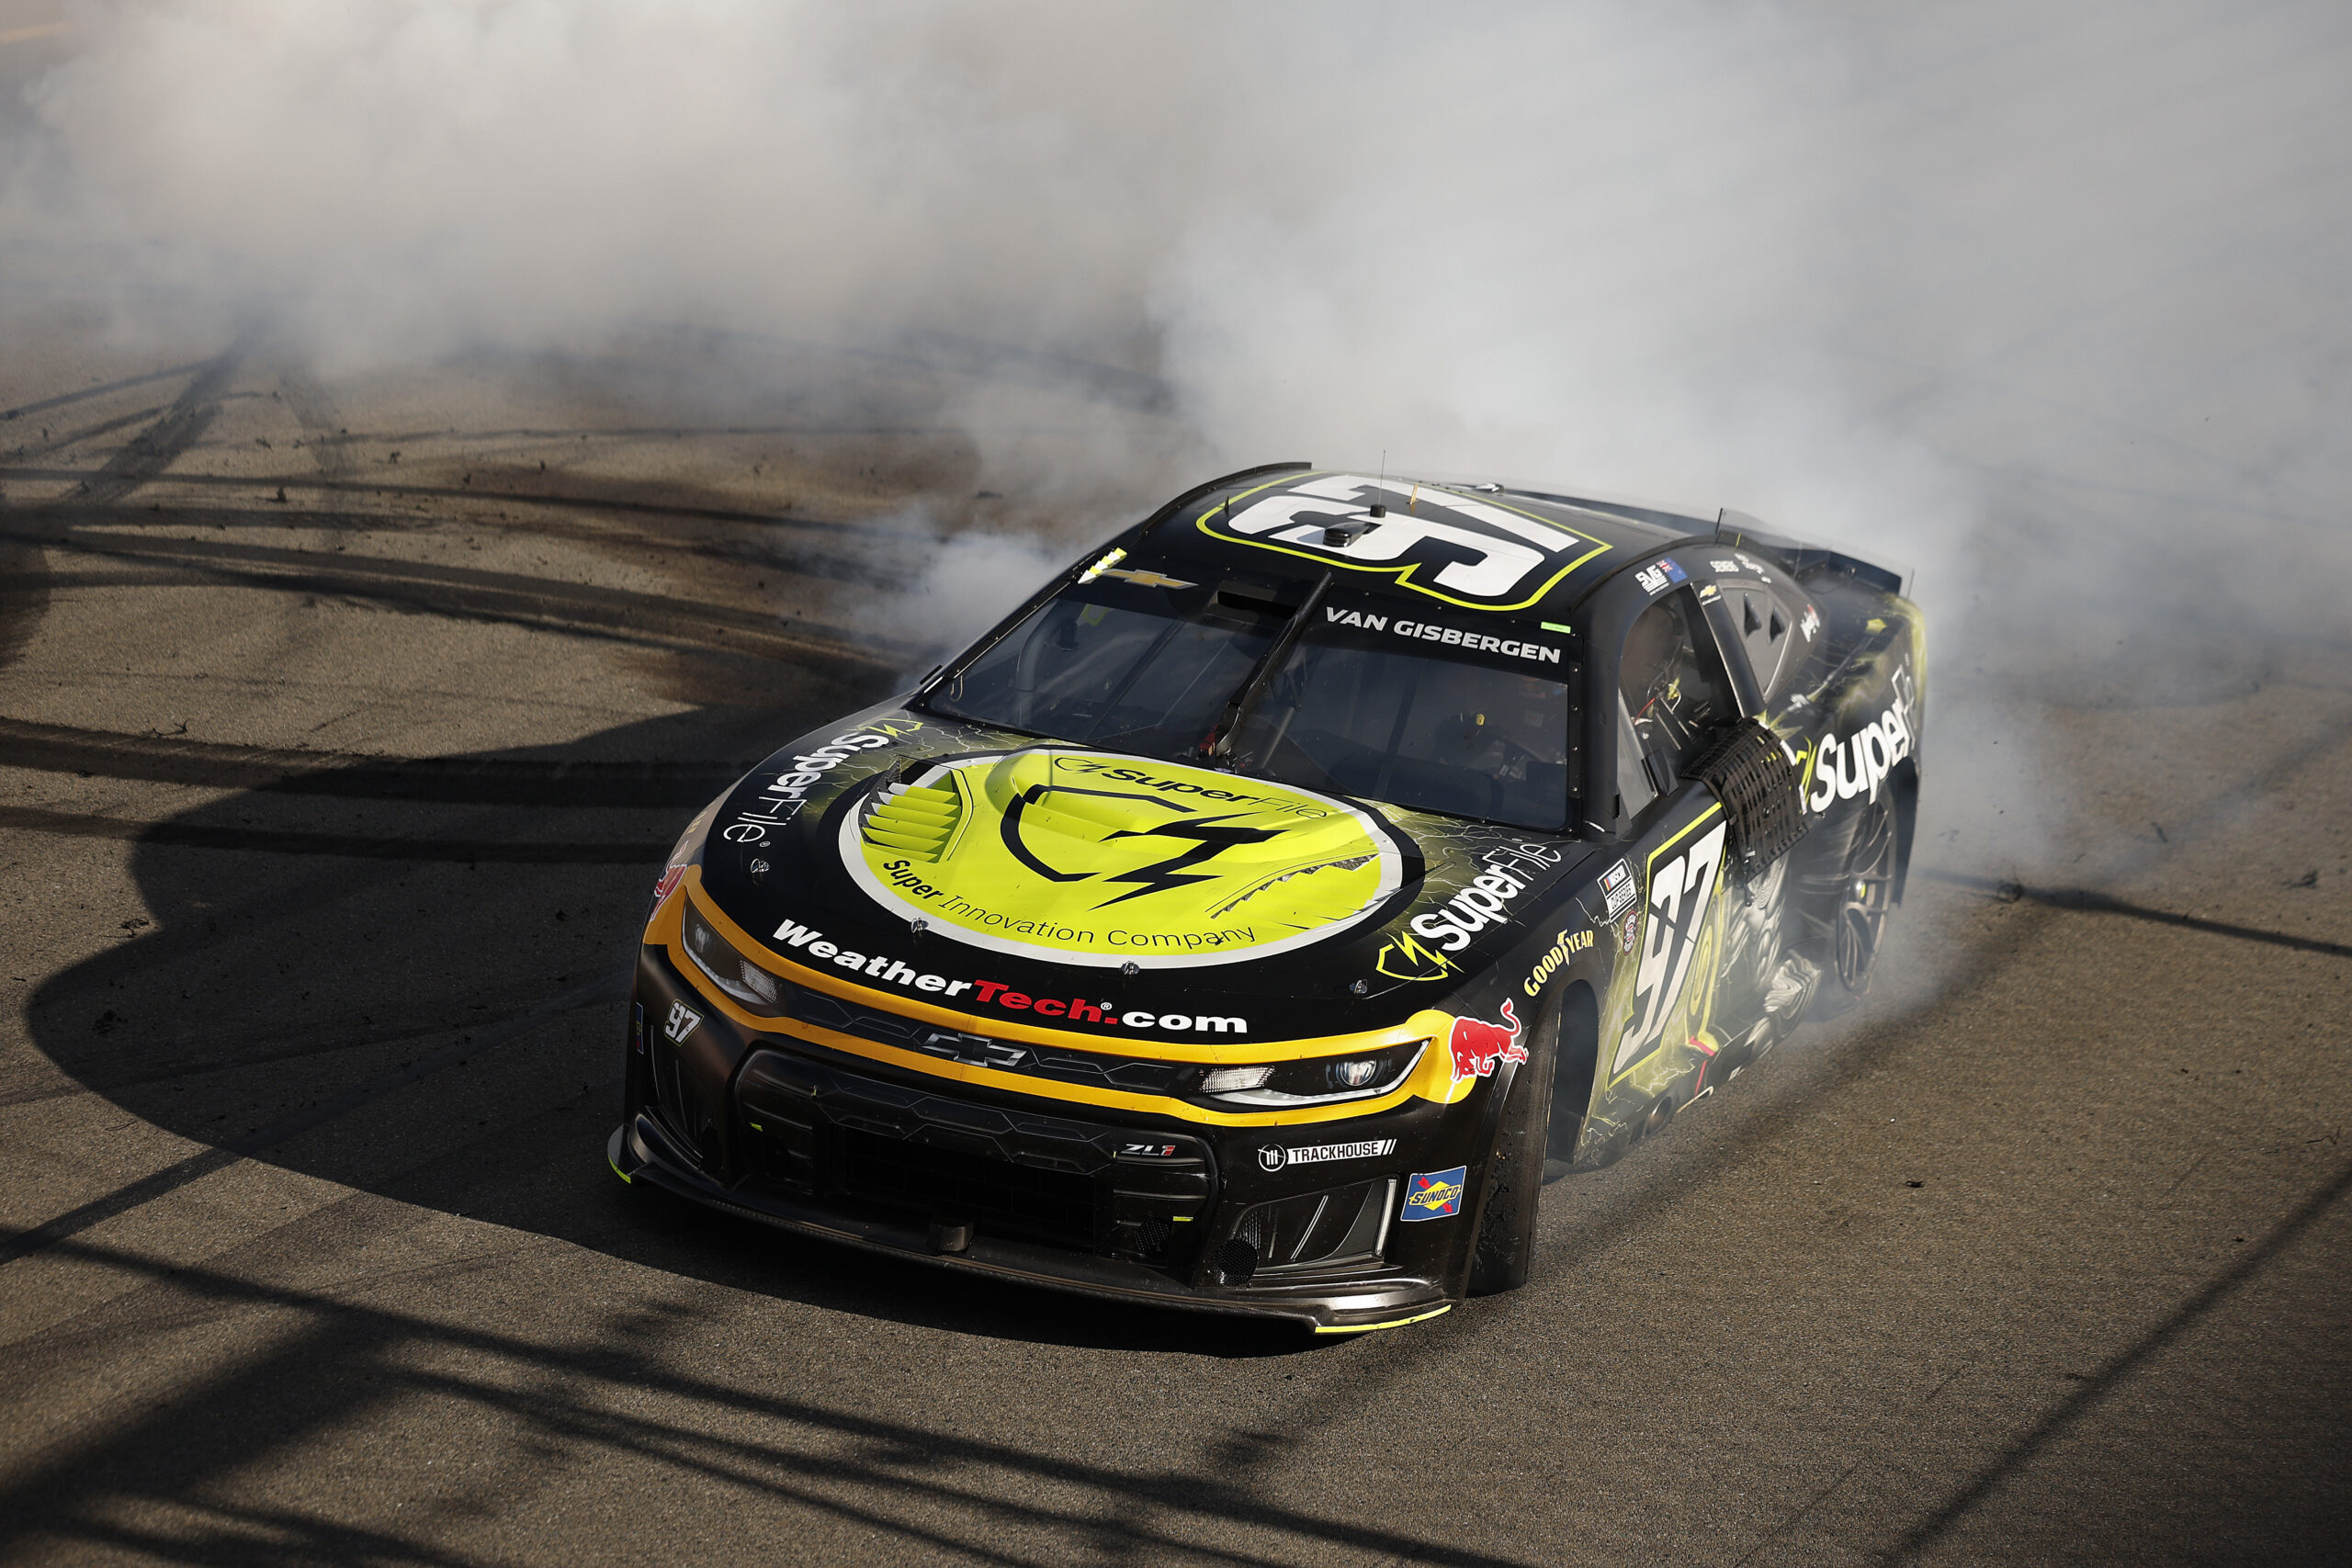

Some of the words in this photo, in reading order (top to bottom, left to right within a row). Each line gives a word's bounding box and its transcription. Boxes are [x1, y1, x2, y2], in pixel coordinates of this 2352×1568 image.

[1326, 606, 1387, 631] VAN
[1393, 620, 1562, 663] GISBERGEN
[1102, 768, 1327, 819] SuperFile
[883, 859, 944, 900] Super
[938, 895, 1094, 944] Innovation
[1106, 926, 1257, 950] Company
[1409, 843, 1562, 952] SuperFile
[1523, 929, 1594, 997] GOODYEAR
[1613, 820, 1726, 1074] 97
[664, 1001, 696, 1043] 97
[1121, 1144, 1176, 1156] ZL1
[1292, 1141, 1379, 1163] TRACKHOUSE
[1409, 1182, 1462, 1206] SUNOCO
